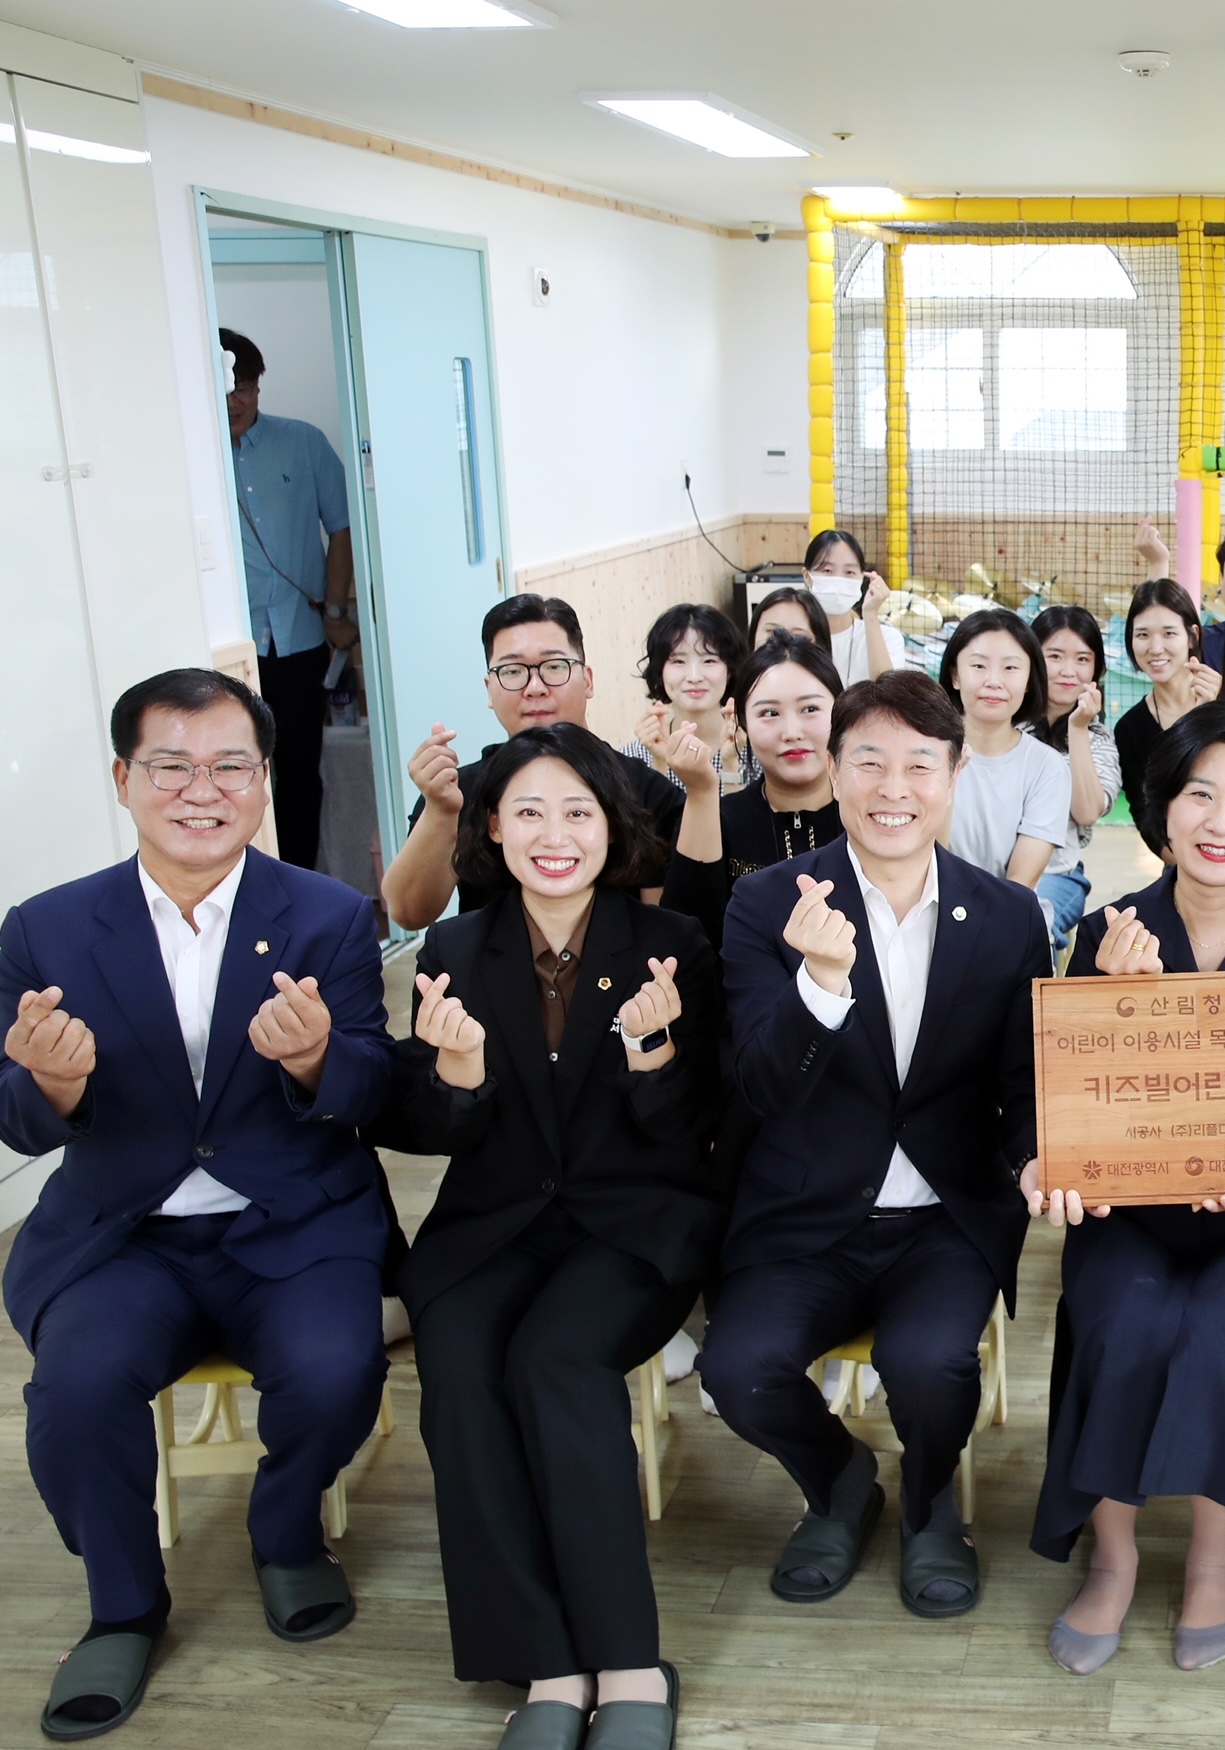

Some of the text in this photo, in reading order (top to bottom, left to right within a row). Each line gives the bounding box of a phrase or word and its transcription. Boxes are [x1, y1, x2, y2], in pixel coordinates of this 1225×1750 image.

[1057, 1033, 1115, 1054] 어린이
[1123, 1030, 1201, 1052] 이용시설
[1125, 1125, 1162, 1139] 시공사
[1107, 1161, 1169, 1176] 대전광역시
